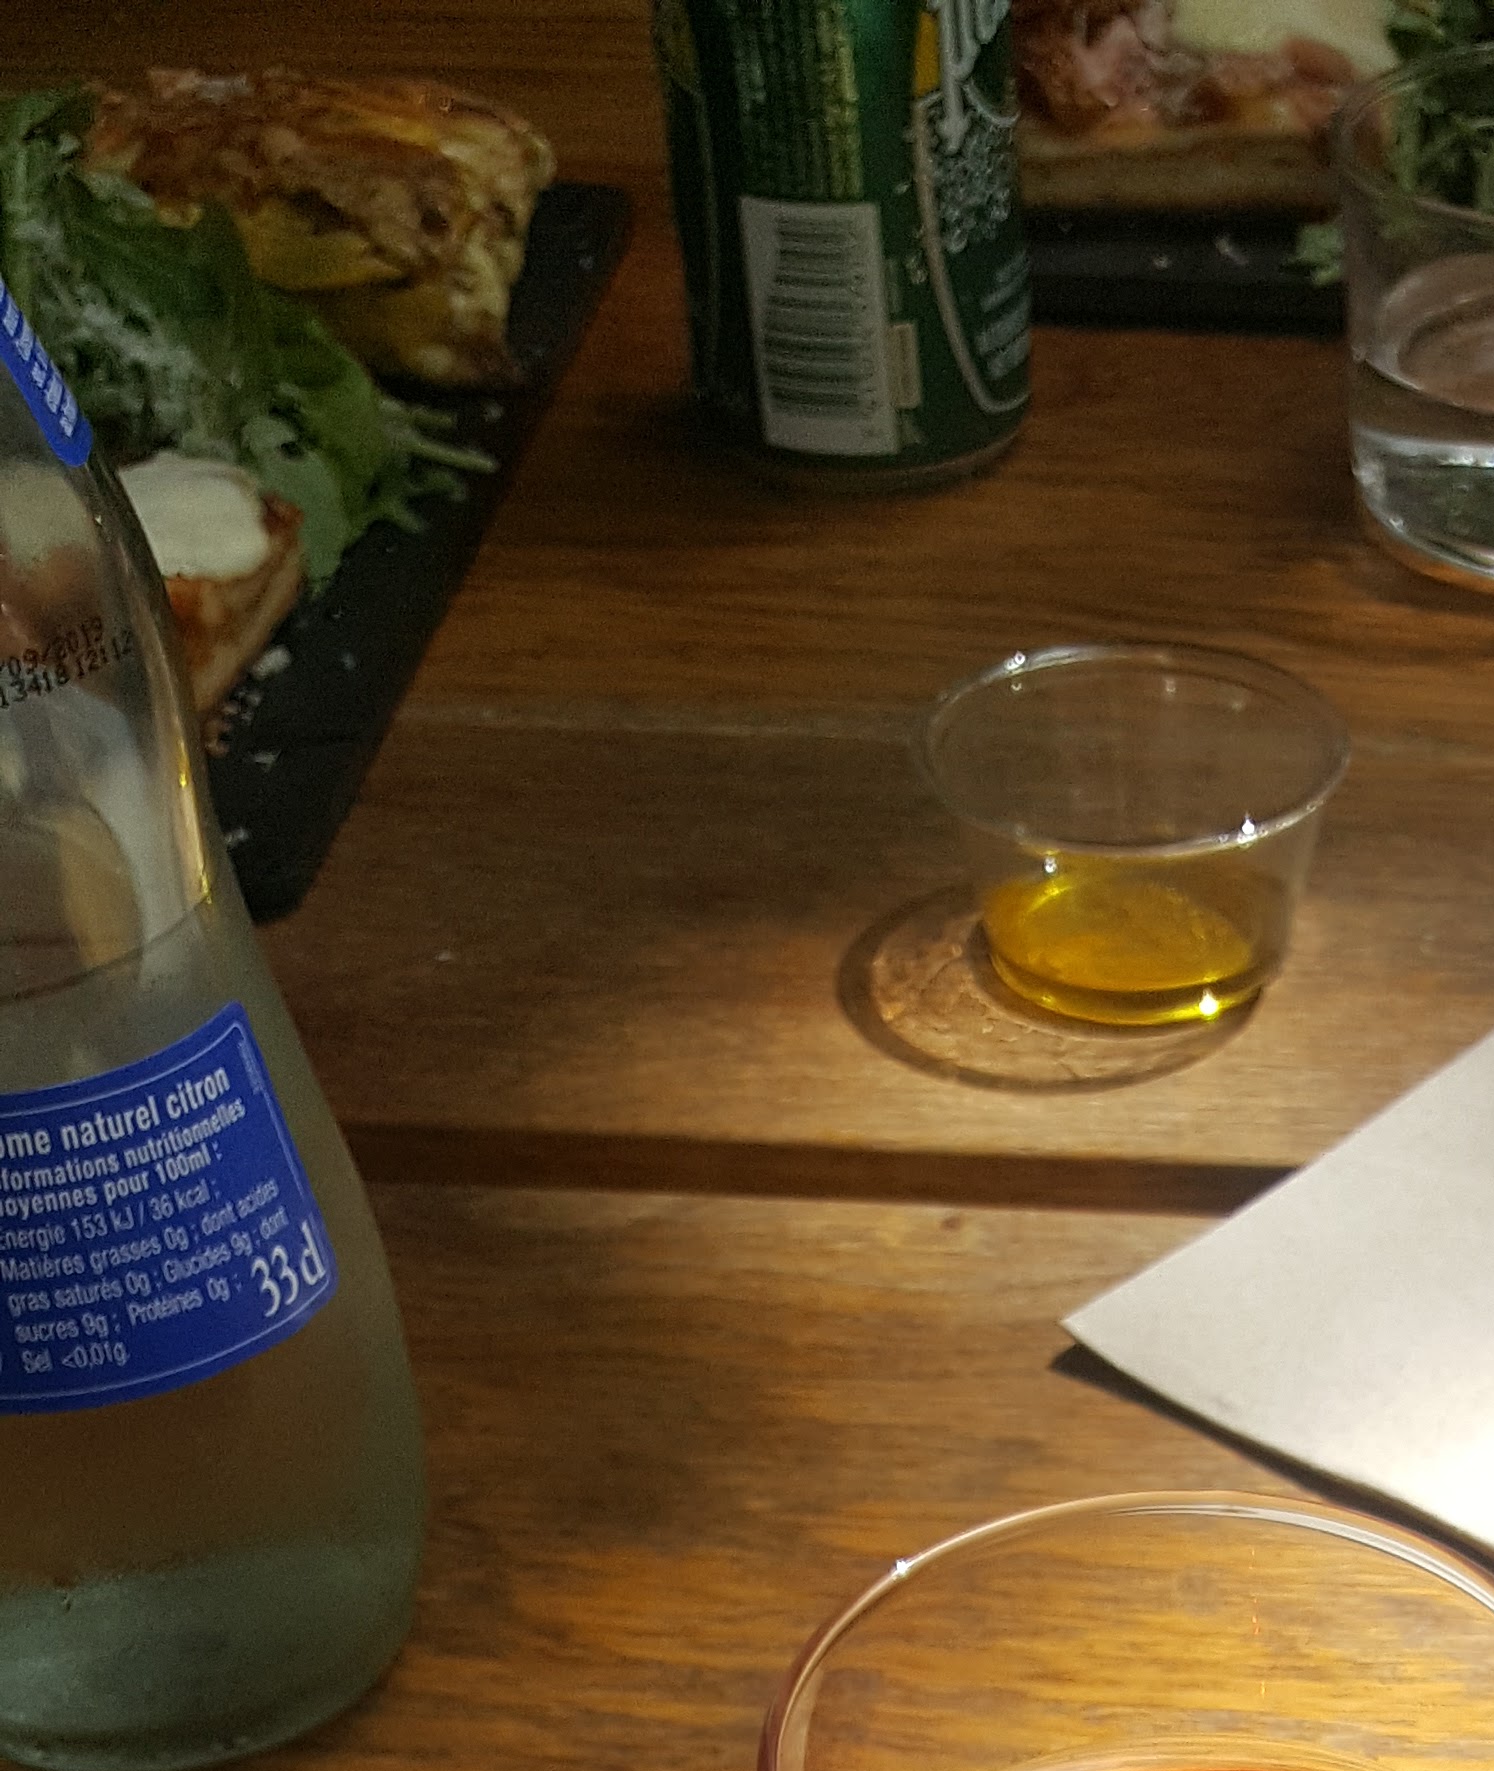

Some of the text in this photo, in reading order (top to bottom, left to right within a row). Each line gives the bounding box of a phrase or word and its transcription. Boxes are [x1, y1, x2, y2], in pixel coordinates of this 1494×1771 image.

[60, 1095, 161, 1151] naturel
[166, 1067, 231, 1120] citron
[0, 1097, 247, 1192] formations nutritionnelles
[103, 1170, 150, 1206] pour
[154, 1141, 212, 1185] 100ml
[1, 1253, 85, 1282] Matières
[90, 1236, 162, 1275] grasses
[201, 1201, 238, 1236] dont
[70, 1212, 108, 1241] 153
[109, 1205, 135, 1233] kJ
[149, 1193, 174, 1221] 36
[173, 1178, 210, 1213] kcal
[8, 1290, 50, 1318] gras
[53, 1276, 124, 1309] saturés
[14, 1319, 80, 1344] sucres
